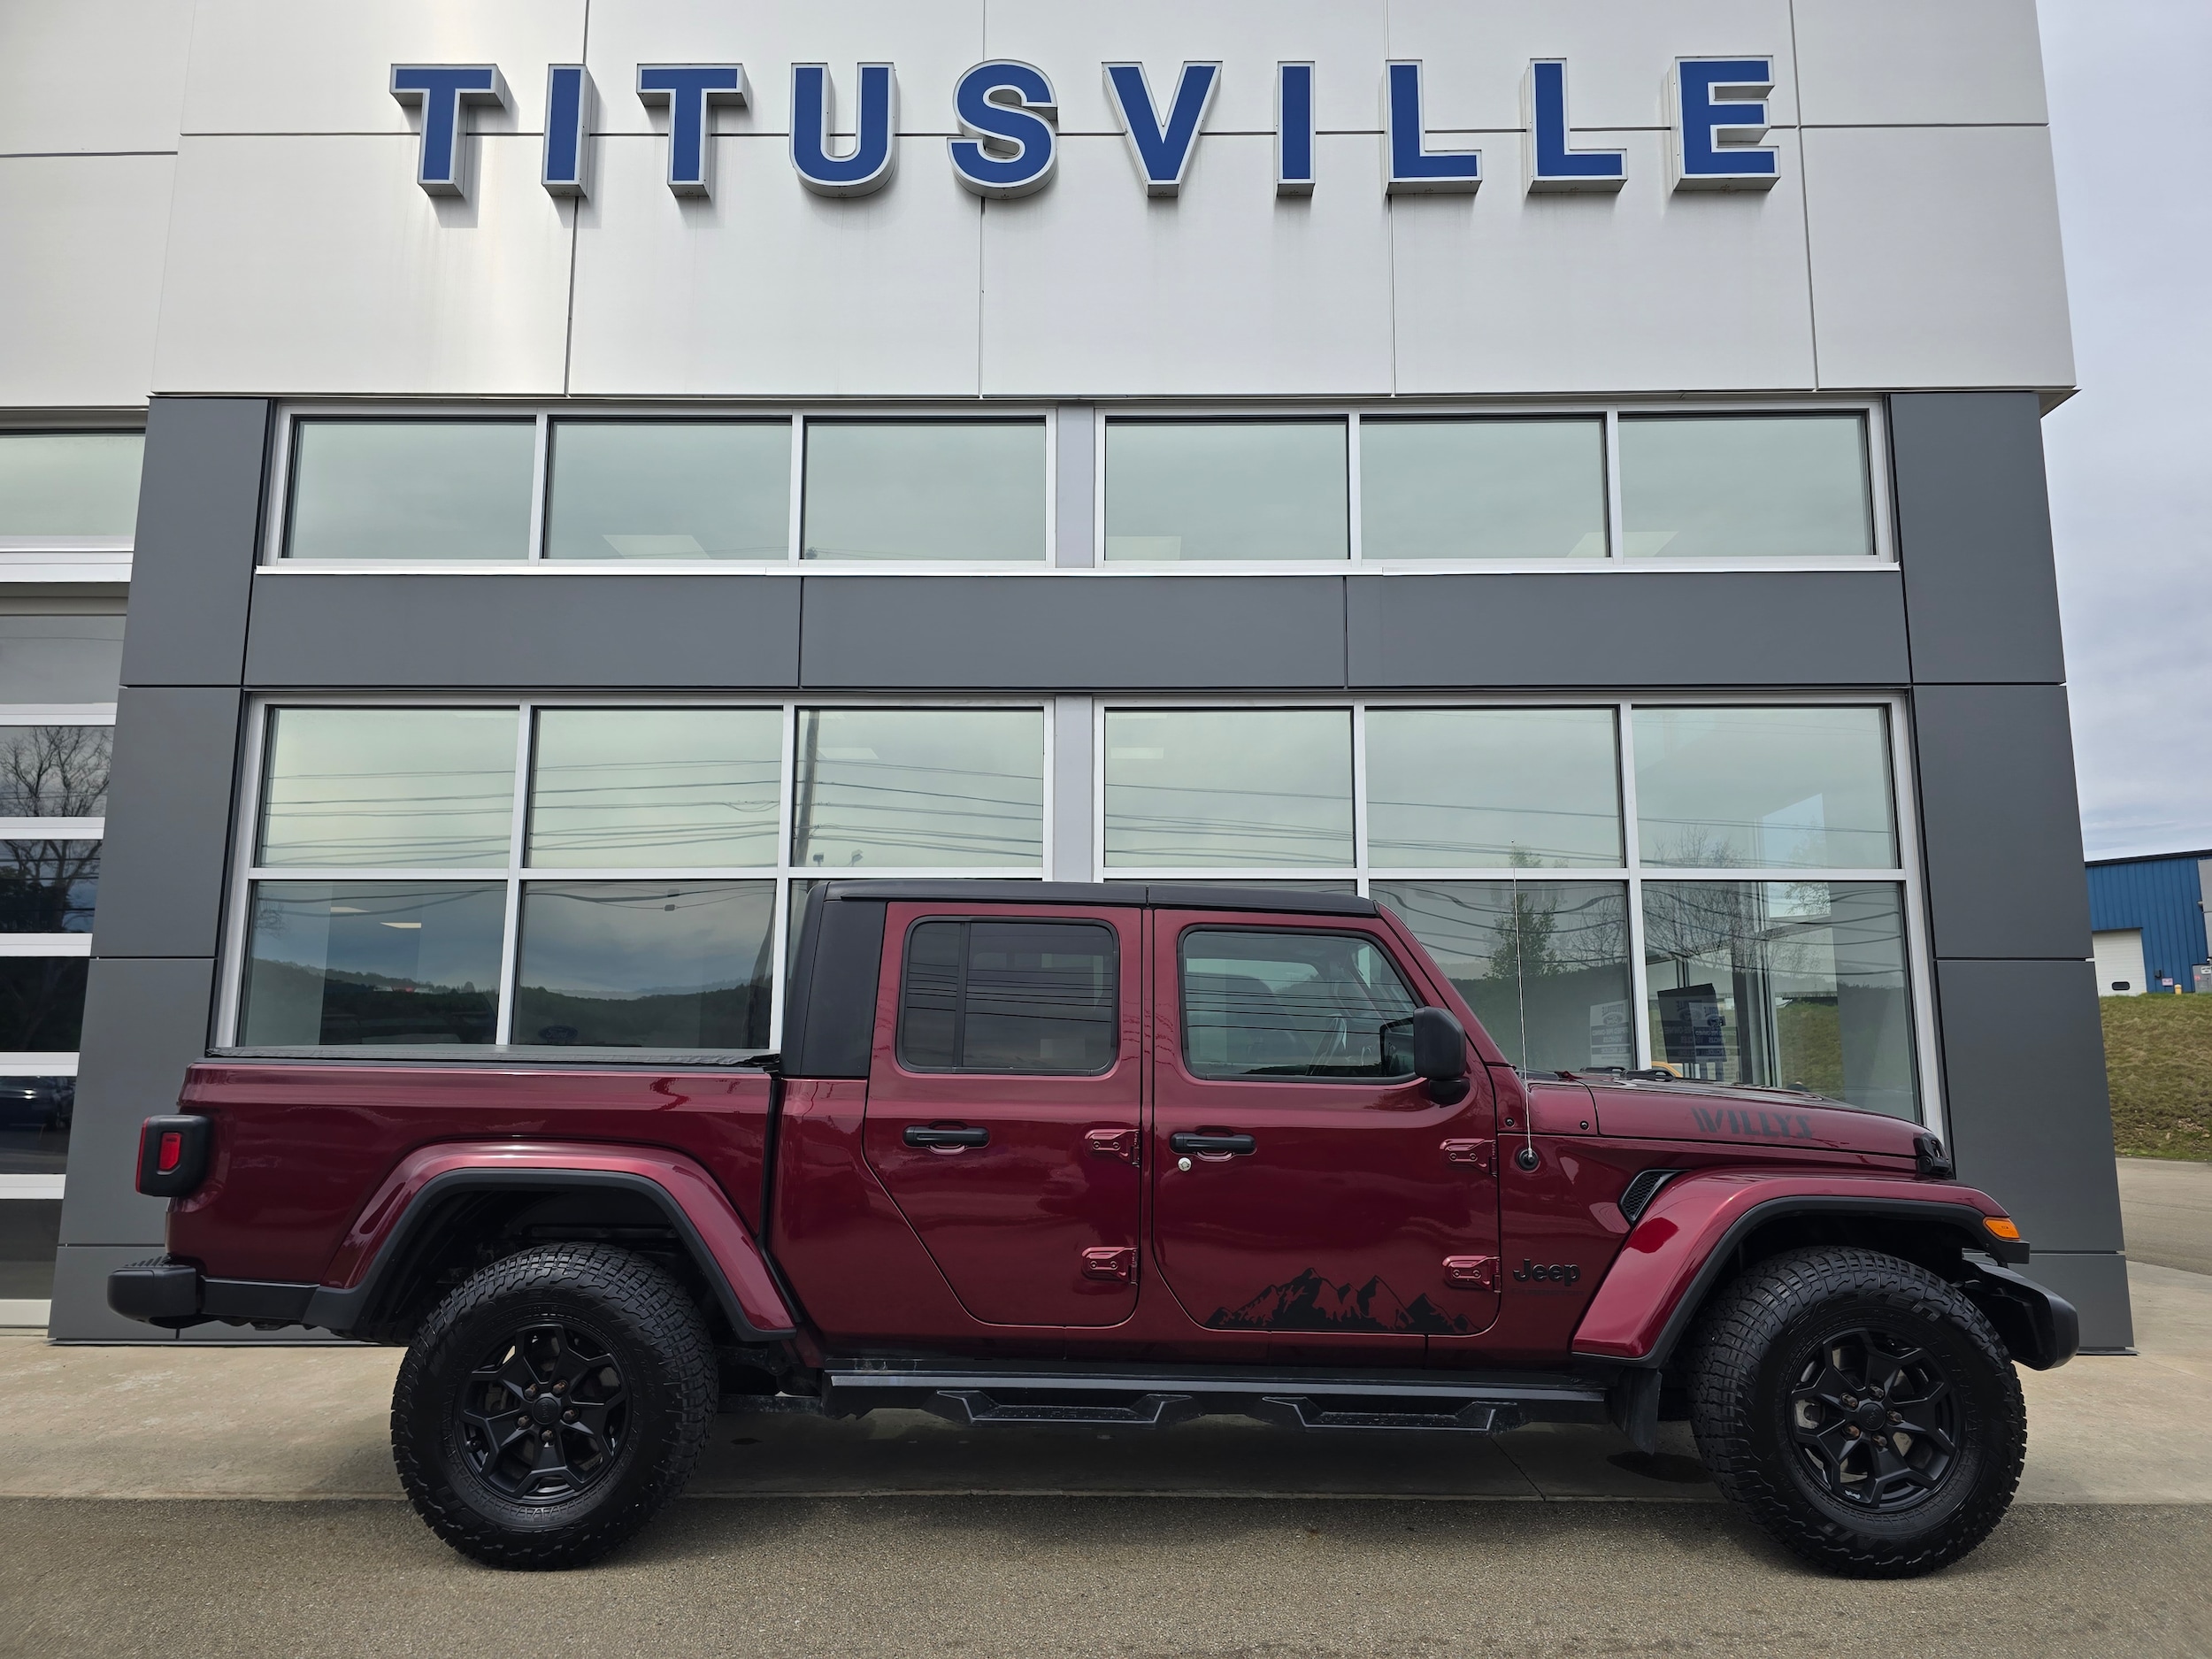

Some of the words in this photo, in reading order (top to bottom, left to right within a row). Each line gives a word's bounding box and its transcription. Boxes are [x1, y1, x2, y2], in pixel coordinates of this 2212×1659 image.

[389, 56, 1781, 196] TITUSVILLE
[1691, 1106, 1813, 1139] WILLYS
[1513, 1258, 1580, 1286] Jeep
